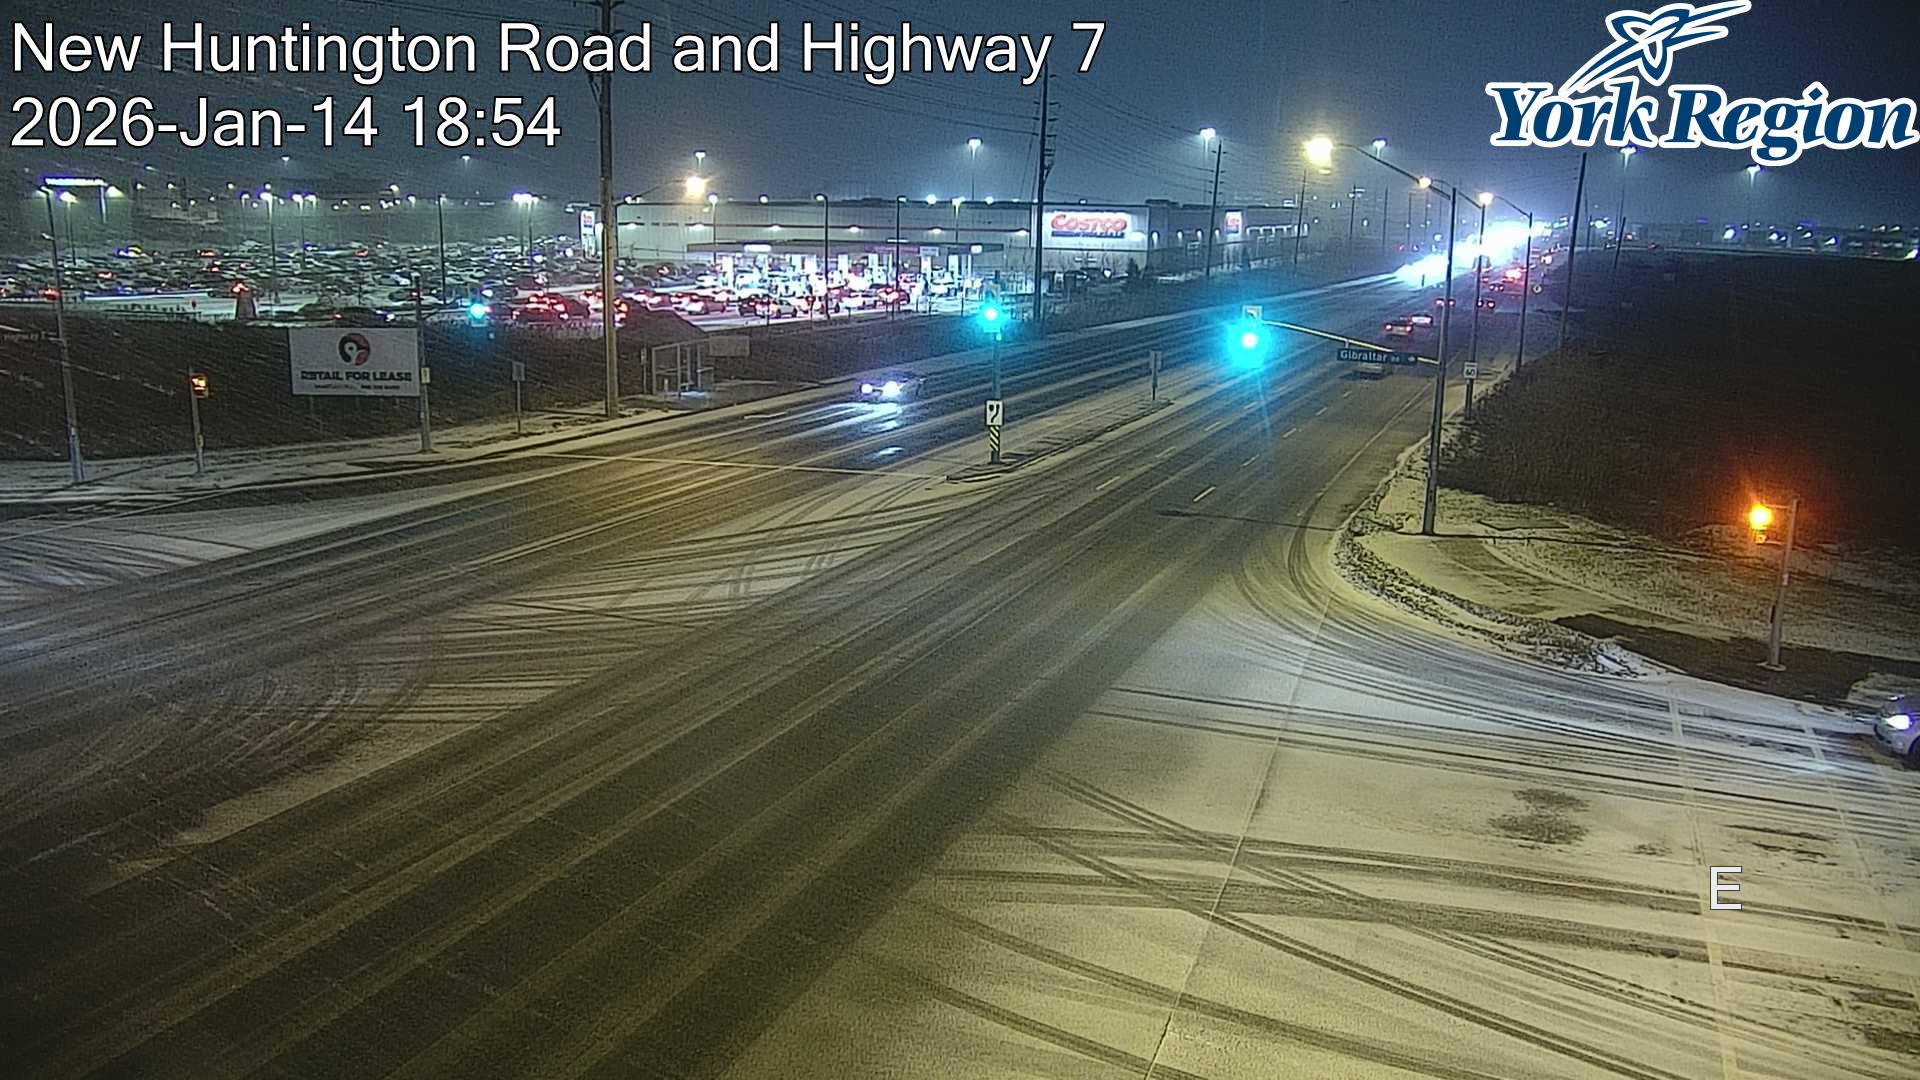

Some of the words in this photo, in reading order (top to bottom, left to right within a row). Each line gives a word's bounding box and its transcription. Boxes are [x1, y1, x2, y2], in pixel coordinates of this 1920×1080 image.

[1340, 350, 1387, 362] Gibraltar
[301, 370, 342, 380] RETAIL
[345, 371, 370, 381] FOR
[373, 371, 412, 382] LEASE
